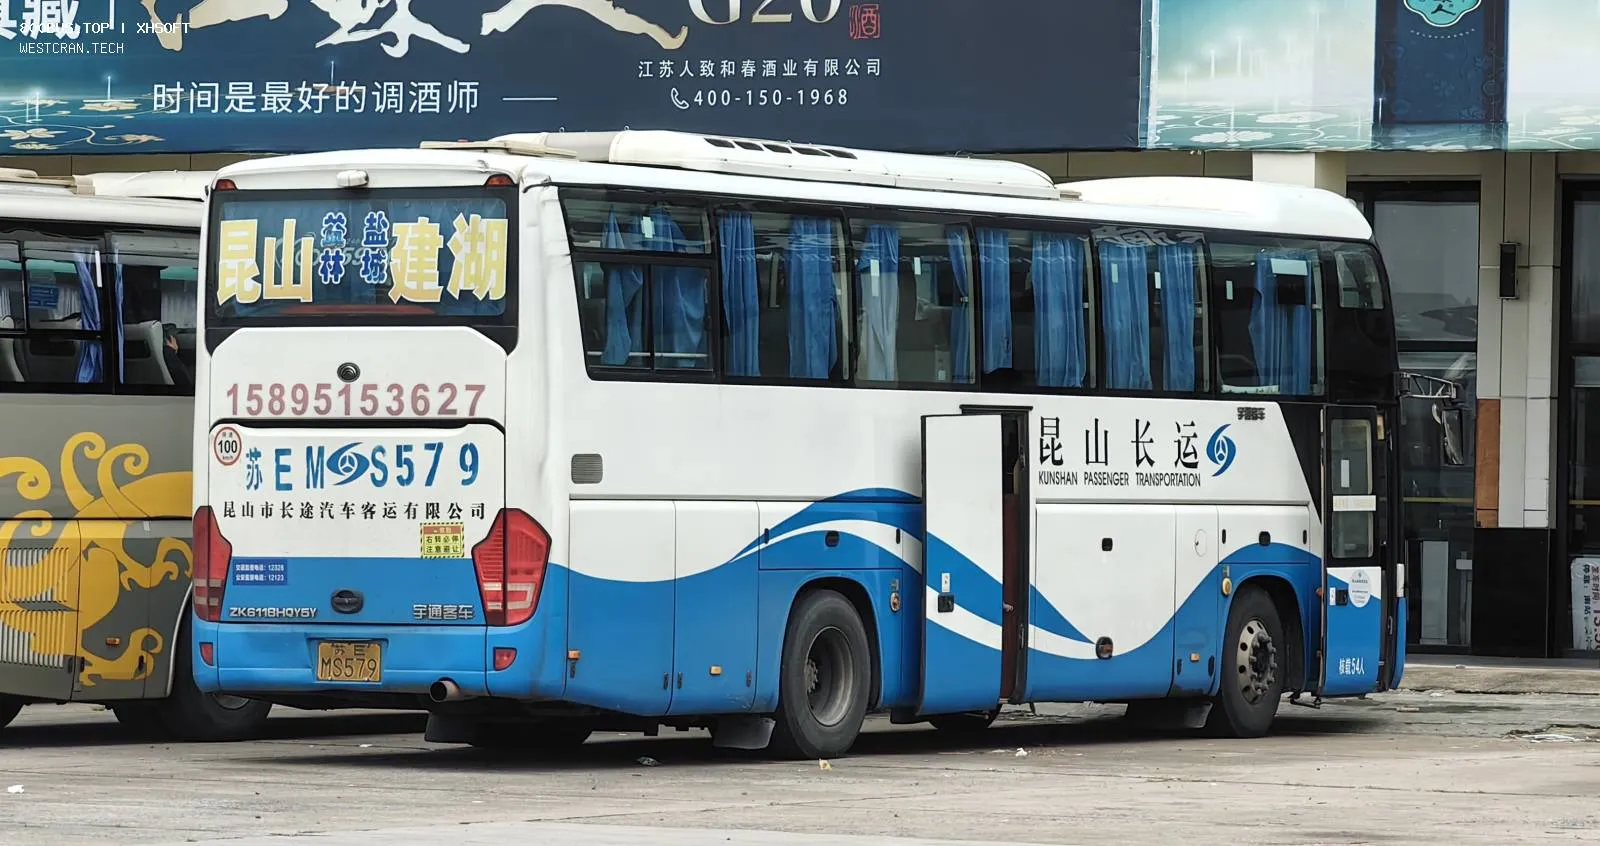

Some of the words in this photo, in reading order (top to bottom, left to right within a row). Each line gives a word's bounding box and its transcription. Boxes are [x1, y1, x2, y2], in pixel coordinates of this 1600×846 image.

[638, 59, 881, 78] 江苏人致和春酒业有限公司
[153, 80, 480, 115] 时间是最好的调酒师
[694, 89, 849, 106] 400-150-1968
[216, 218, 314, 306] 昆山
[360, 211, 390, 284] 盐城
[388, 212, 509, 305] 建湖
[226, 383, 487, 417] 15895153627
[218, 440, 238, 454] 100
[1039, 416, 1200, 469] 昆山长运
[1038, 471, 1078, 486] KUNSHAN
[1083, 472, 1130, 487] PASSENGER
[1135, 472, 1201, 488] TRANSPORTATION
[223, 500, 486, 520] 昆山市长途汽车客运有限公司
[413, 604, 474, 620] 宇通客车
[320, 657, 378, 679] MS579
